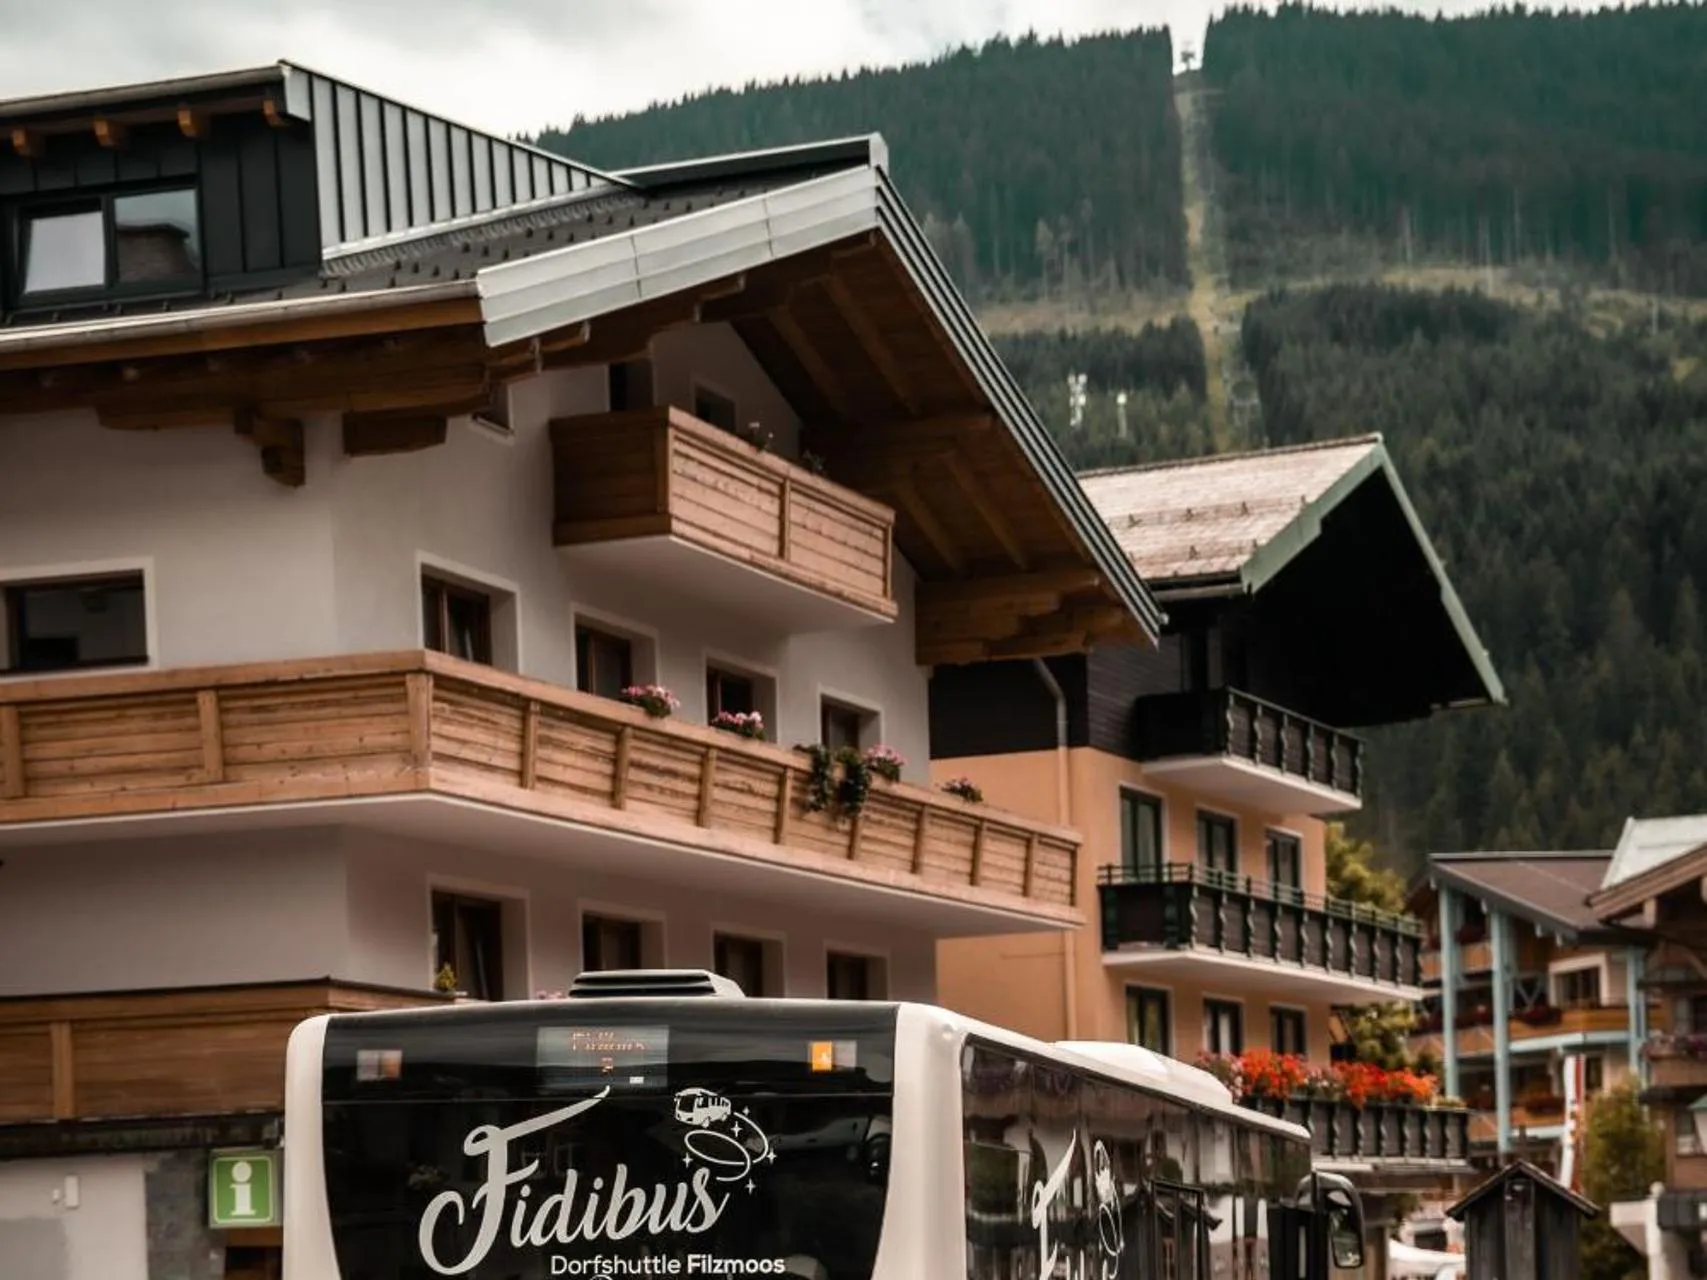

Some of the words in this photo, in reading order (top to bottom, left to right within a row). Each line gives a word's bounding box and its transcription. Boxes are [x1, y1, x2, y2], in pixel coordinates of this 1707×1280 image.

[418, 1085, 730, 1276] Fidibus
[550, 1254, 682, 1275] Dorfshuttle
[687, 1253, 786, 1274] Filzmoos
